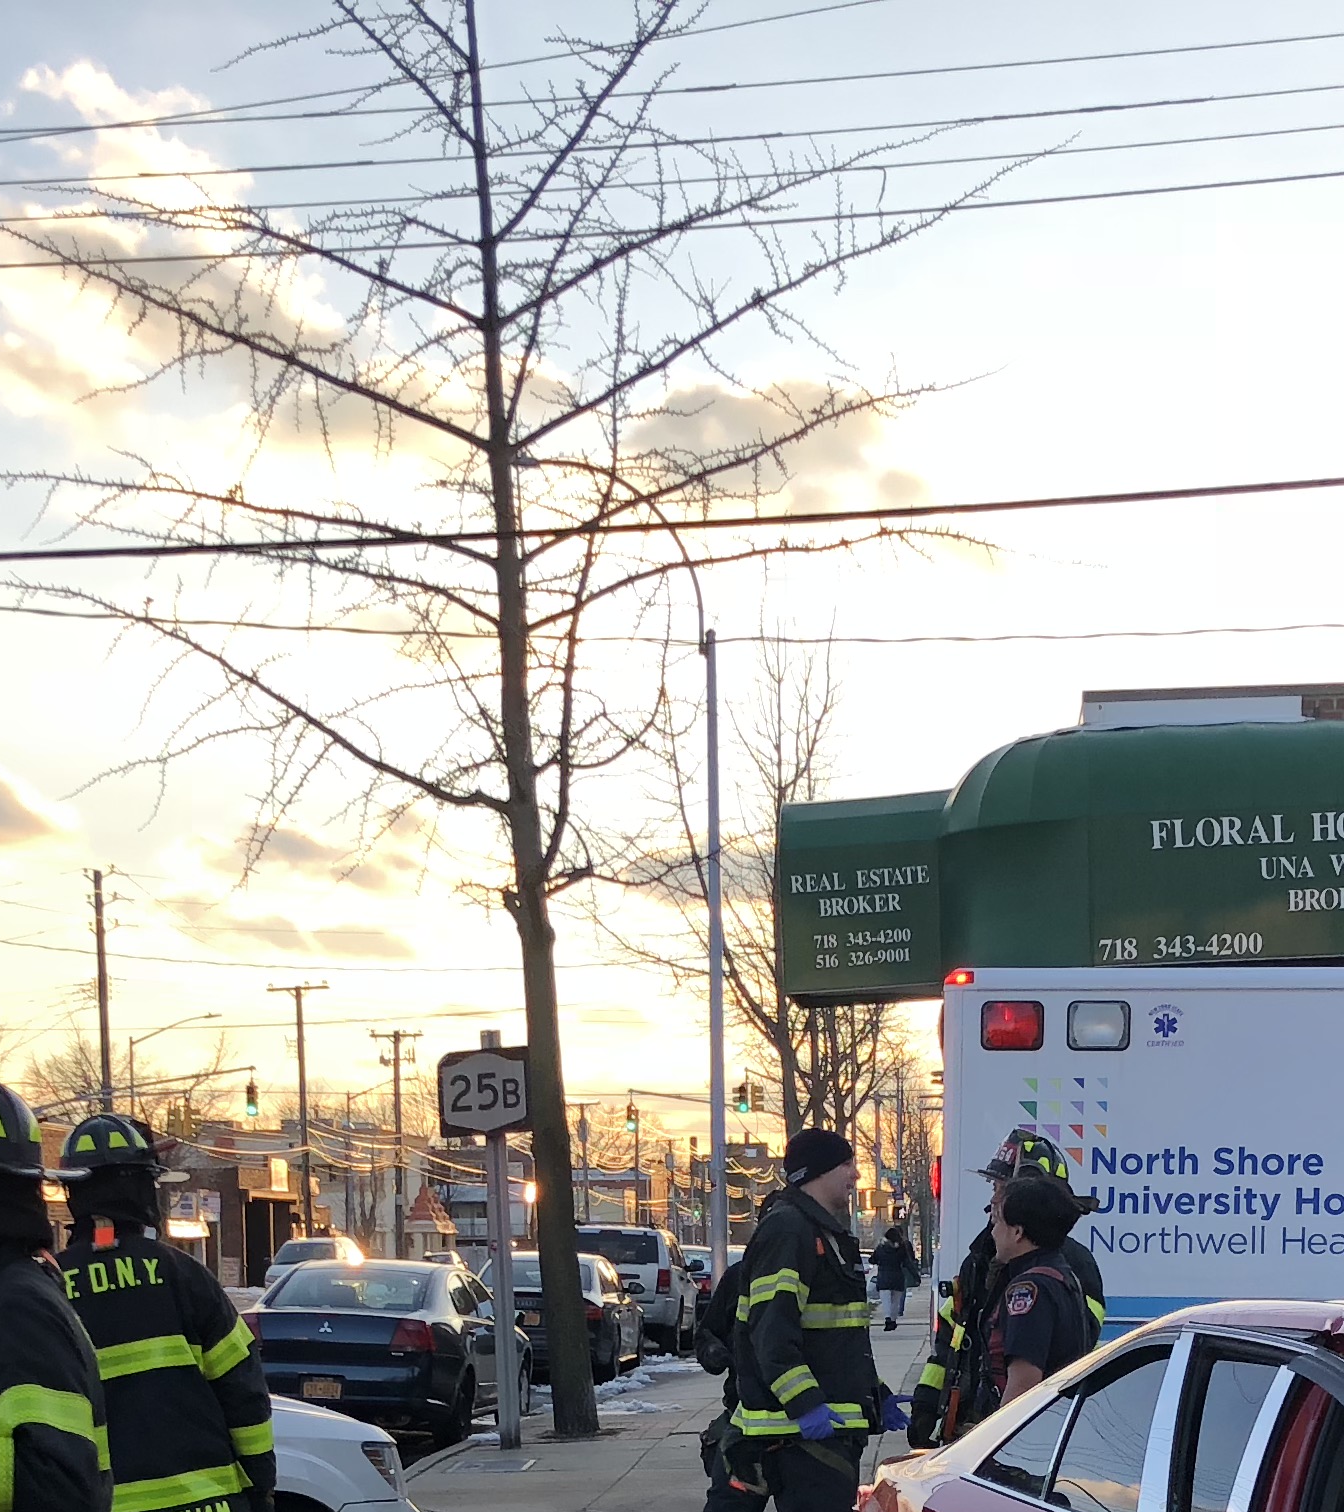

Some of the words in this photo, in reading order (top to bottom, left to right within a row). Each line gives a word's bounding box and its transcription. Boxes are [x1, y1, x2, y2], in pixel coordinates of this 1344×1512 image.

[1150, 814, 1295, 849] FLORAL
[790, 872, 846, 894] REAL
[856, 865, 930, 889] ESTATE
[1259, 856, 1315, 880] UNA
[819, 893, 902, 917] BROKER
[813, 933, 838, 949] 718
[846, 928, 912, 947] 343-4200
[1098, 937, 1138, 962] 718
[1153, 932, 1264, 959] 343-4200
[815, 954, 839, 969] 516
[847, 948, 911, 967] 326-9001
[1091, 1146, 1199, 1175] North
[1213, 1146, 1324, 1176] Shore
[1090, 1186, 1281, 1221] University
[1090, 1225, 1265, 1255] Northwell
